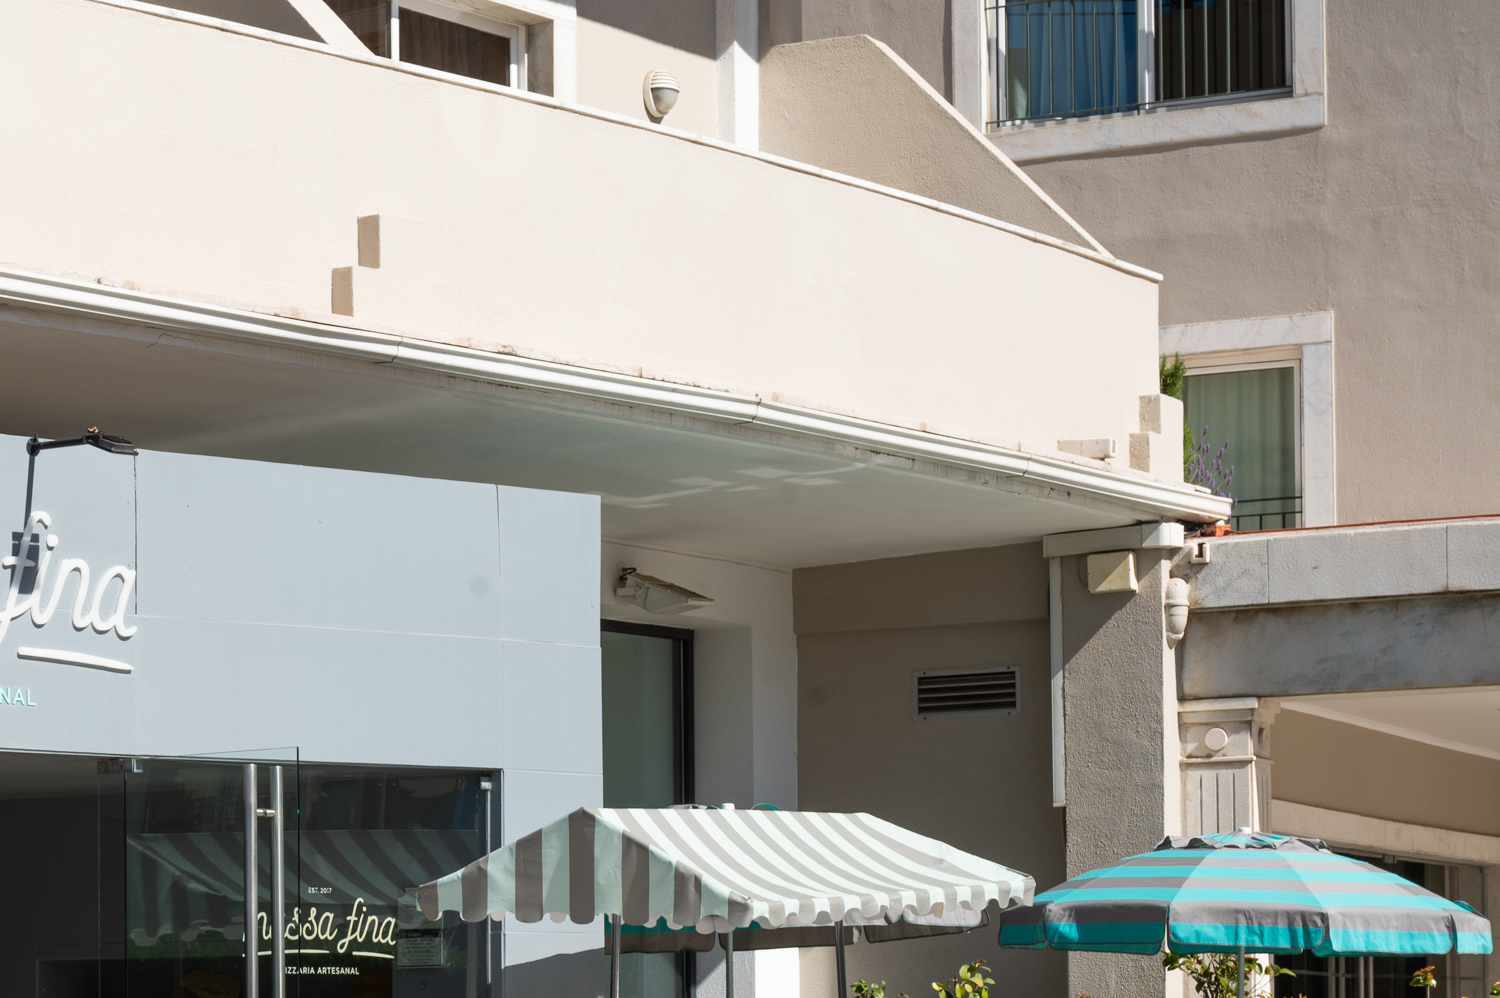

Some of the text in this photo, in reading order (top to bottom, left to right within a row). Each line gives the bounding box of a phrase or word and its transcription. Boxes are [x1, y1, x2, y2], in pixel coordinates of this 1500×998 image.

[337, 897, 396, 954] fina
[284, 966, 360, 975] IZZARIA ARTESANAL
